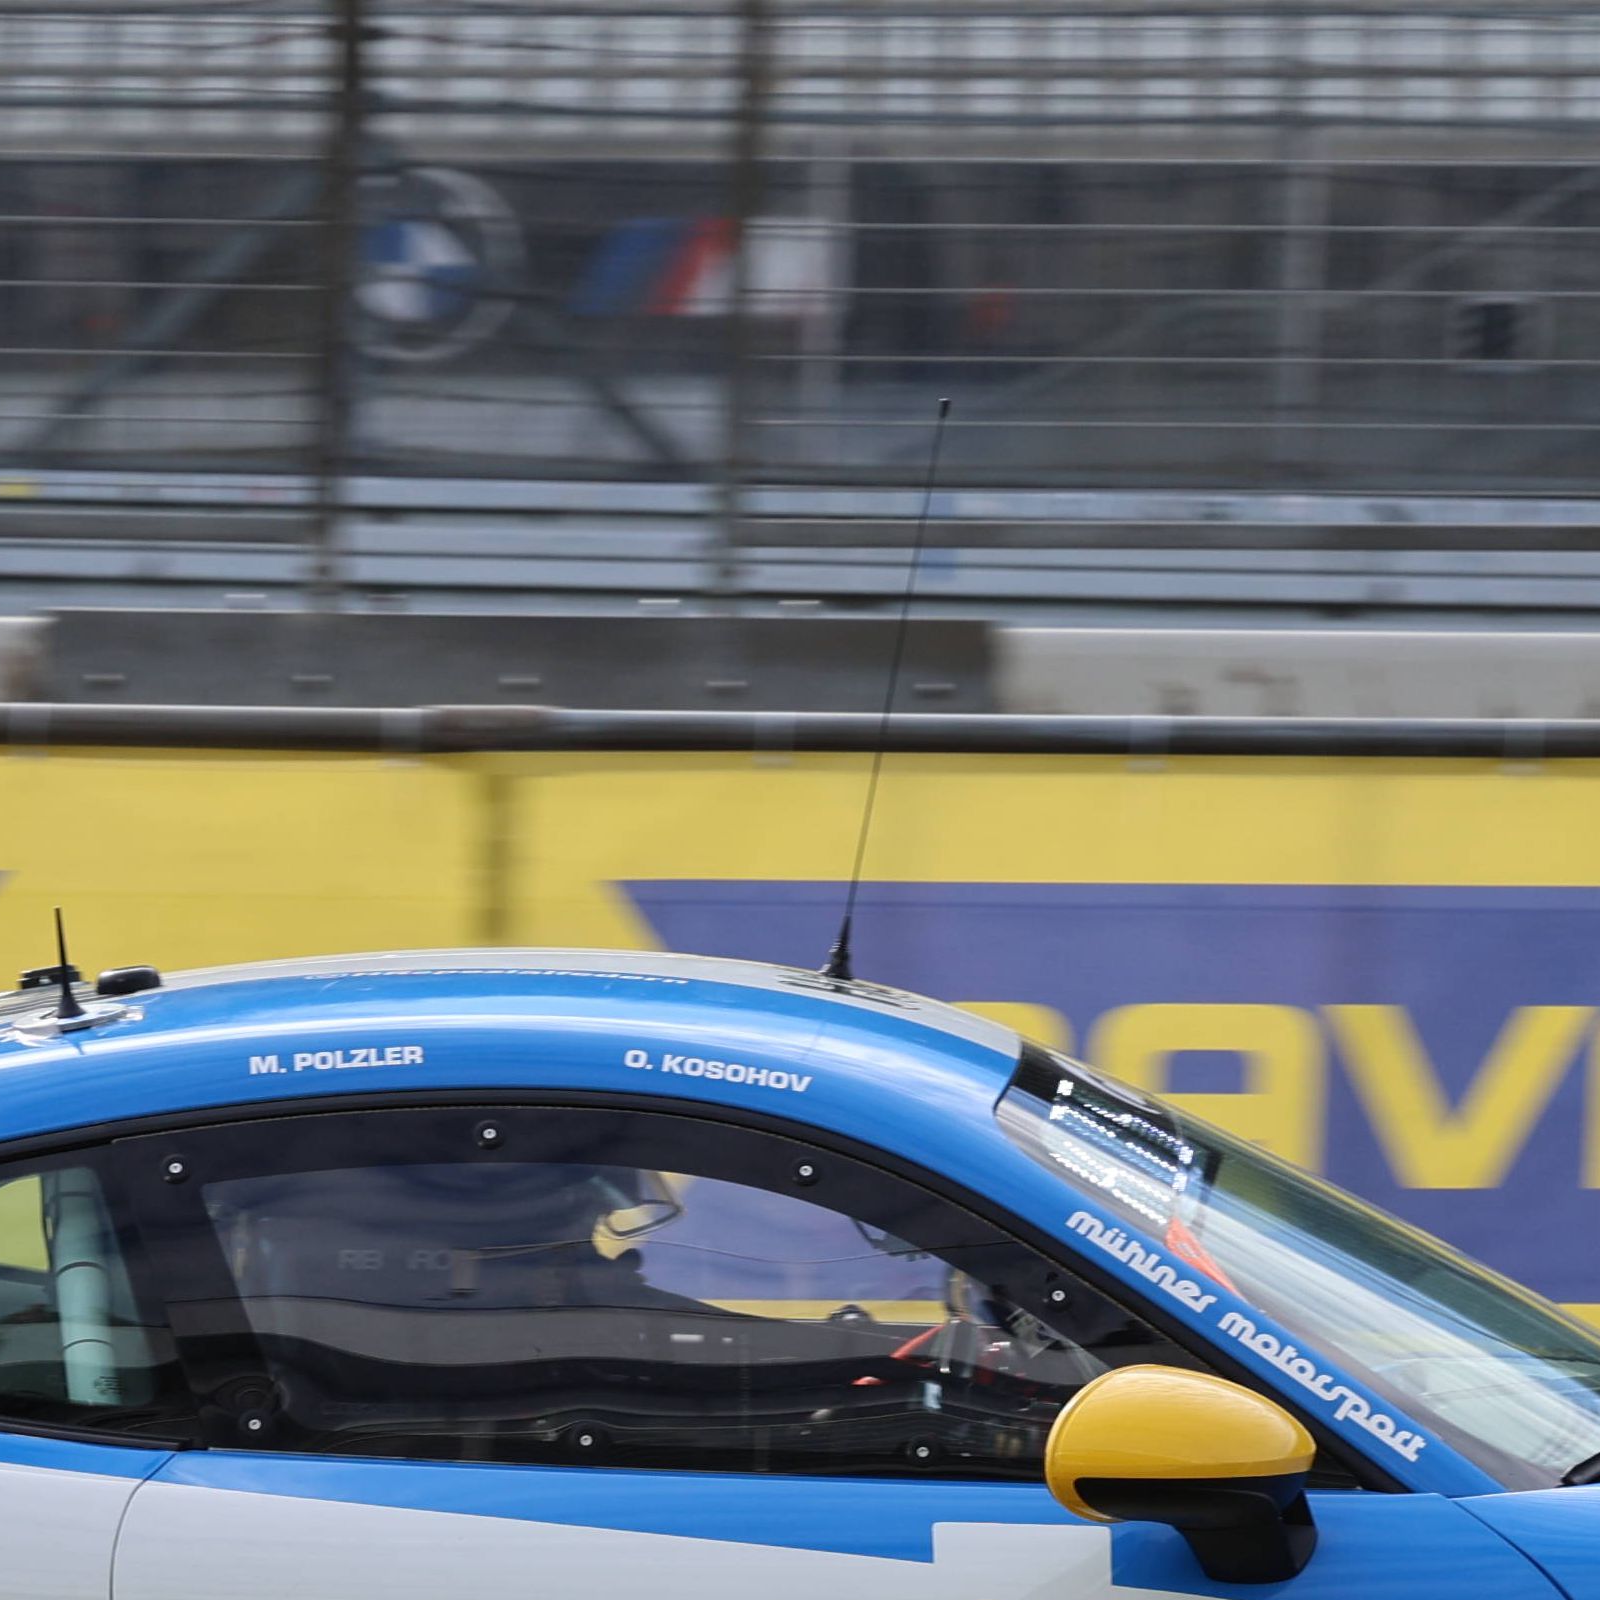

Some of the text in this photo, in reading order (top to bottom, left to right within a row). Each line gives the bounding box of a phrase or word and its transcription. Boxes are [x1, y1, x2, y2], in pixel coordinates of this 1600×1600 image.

[249, 1046, 424, 1075] M. POLZLER
[623, 1049, 814, 1092] O. KOSOHOV
[1064, 1210, 1427, 1462] mühlner motorsport
